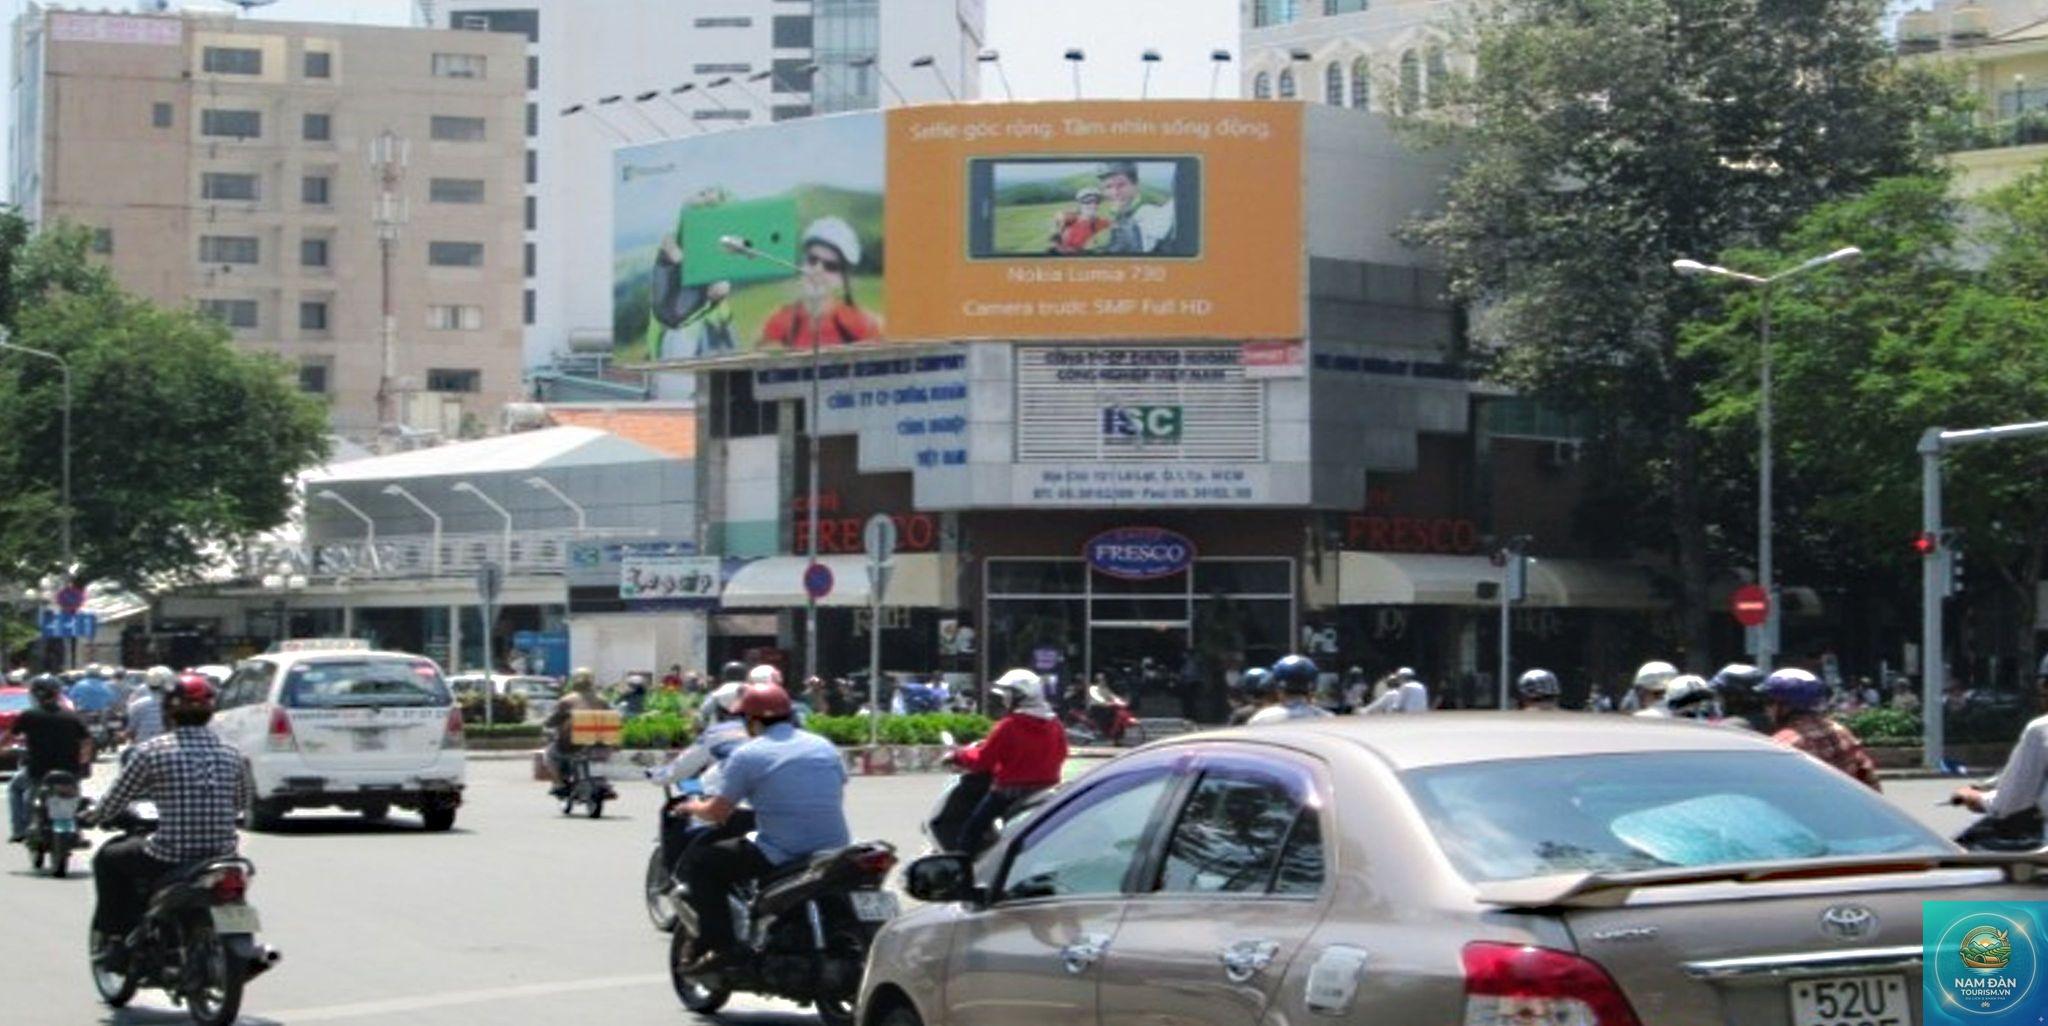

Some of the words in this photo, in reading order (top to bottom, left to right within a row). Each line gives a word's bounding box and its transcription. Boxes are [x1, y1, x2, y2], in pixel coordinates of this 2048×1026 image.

[1007, 266, 1063, 282] Nokia
[963, 299, 1034, 317] Camera
[1181, 300, 1213, 316] HD
[1349, 515, 1476, 551] FRESCO
[1096, 543, 1186, 562] FRESCO
[1815, 979, 1886, 1019] 52U
